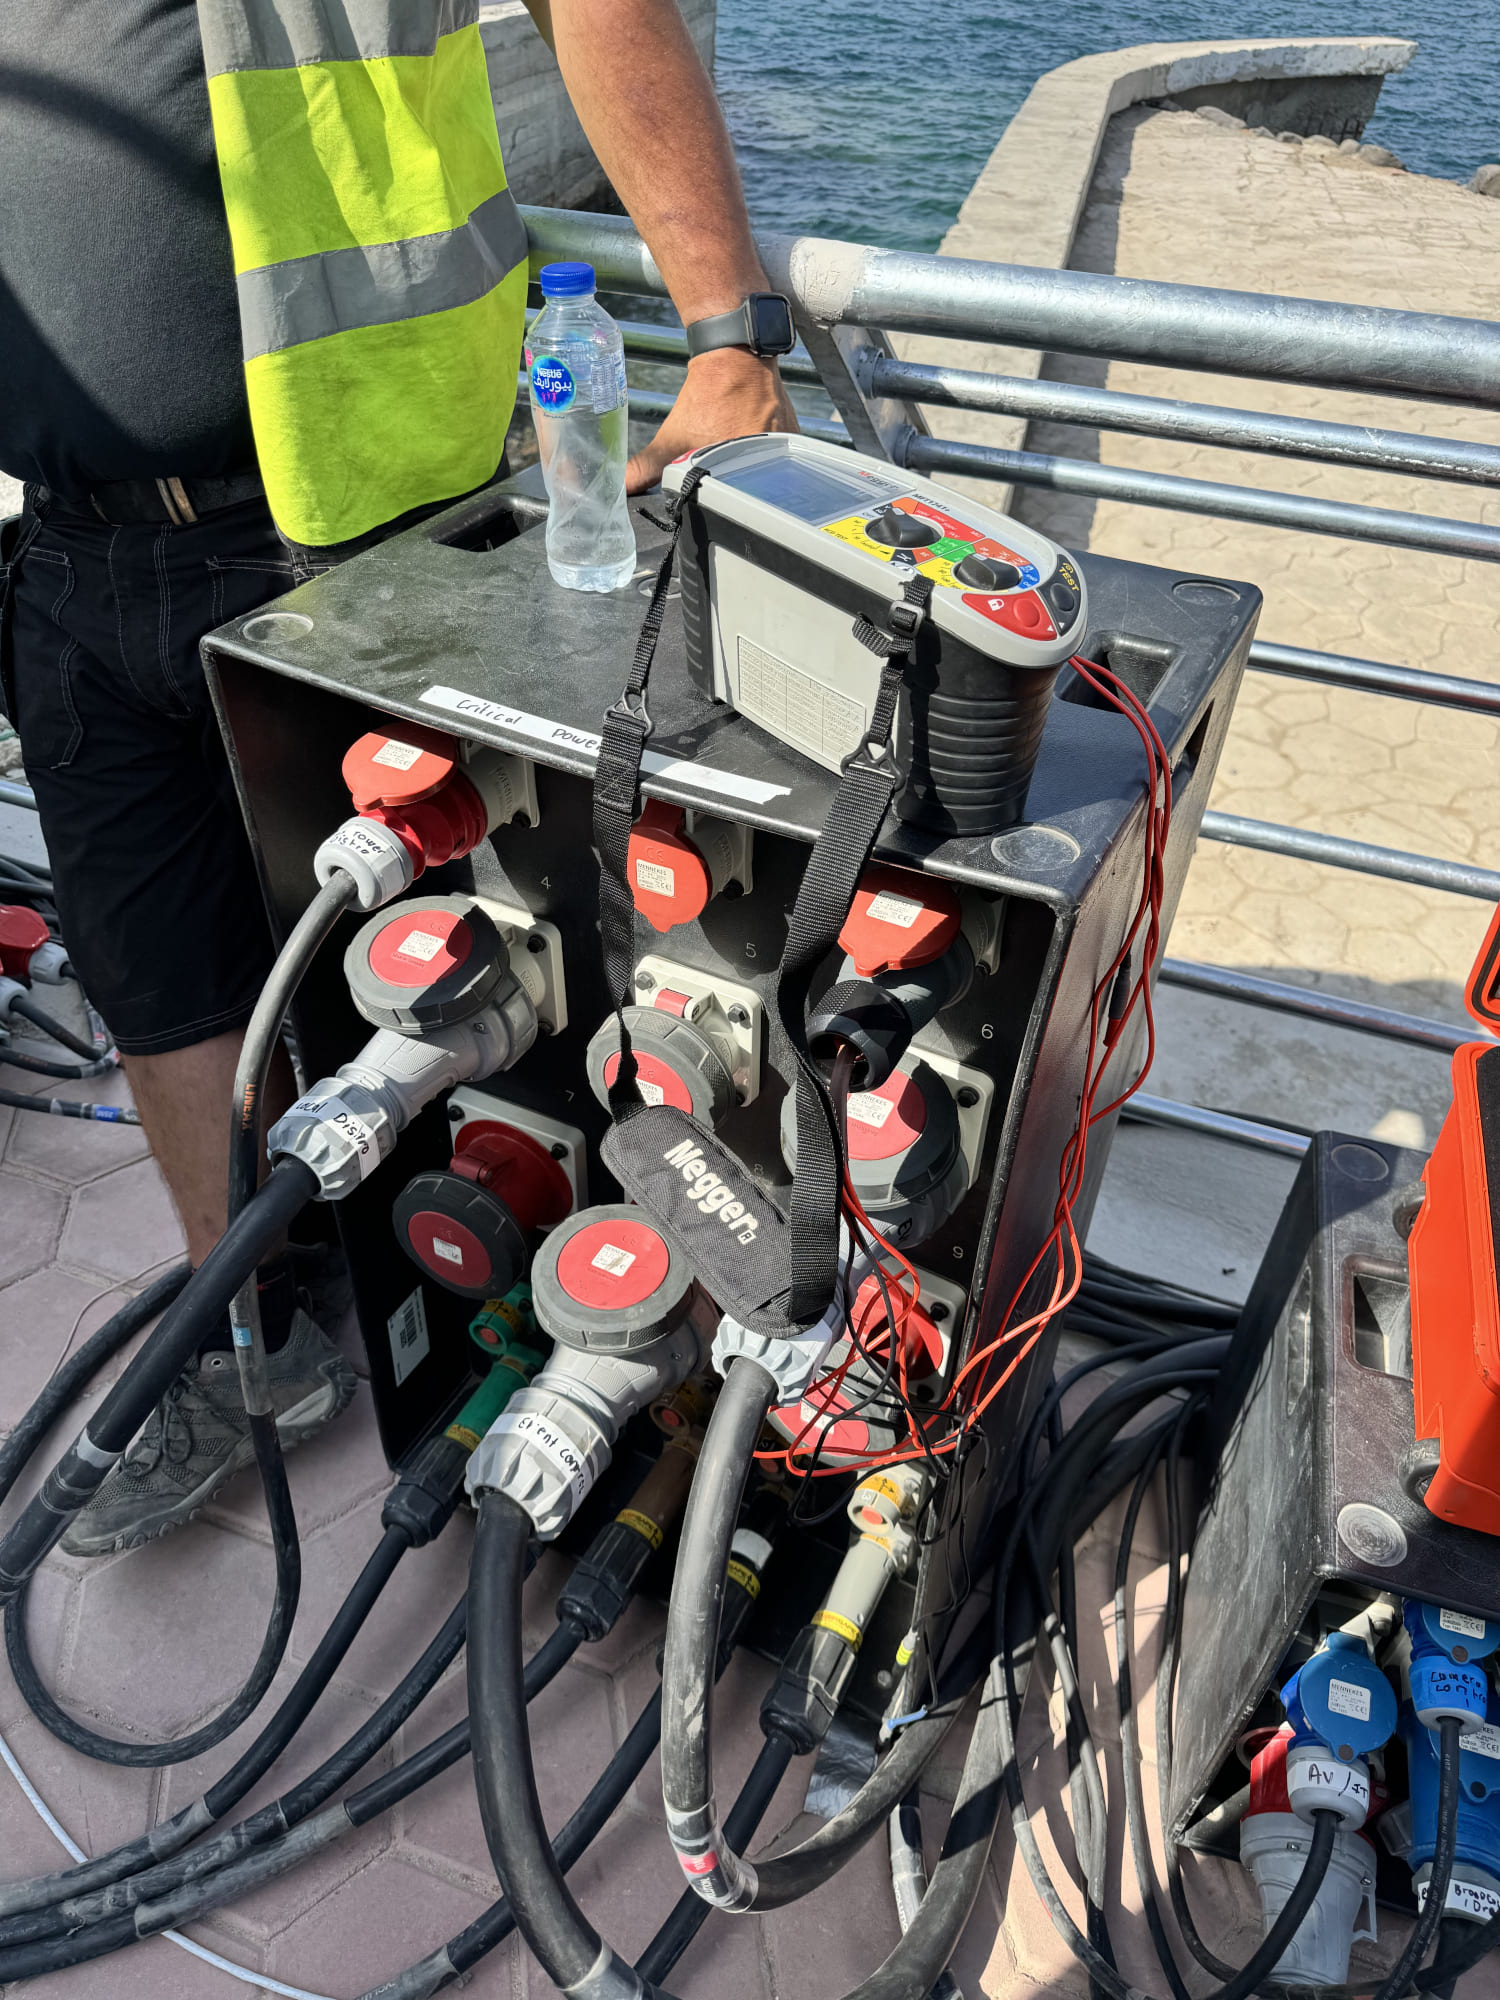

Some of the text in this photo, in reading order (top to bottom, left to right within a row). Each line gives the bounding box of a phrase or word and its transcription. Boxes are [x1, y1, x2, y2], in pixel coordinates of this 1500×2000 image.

[1058, 567, 1080, 592] TEST
[540, 875, 552, 890] 4
[745, 943, 757, 958] 5
[981, 1023, 994, 1039] 6
[663, 1138, 759, 1231] Megger
[952, 1245, 964, 1259] 9
